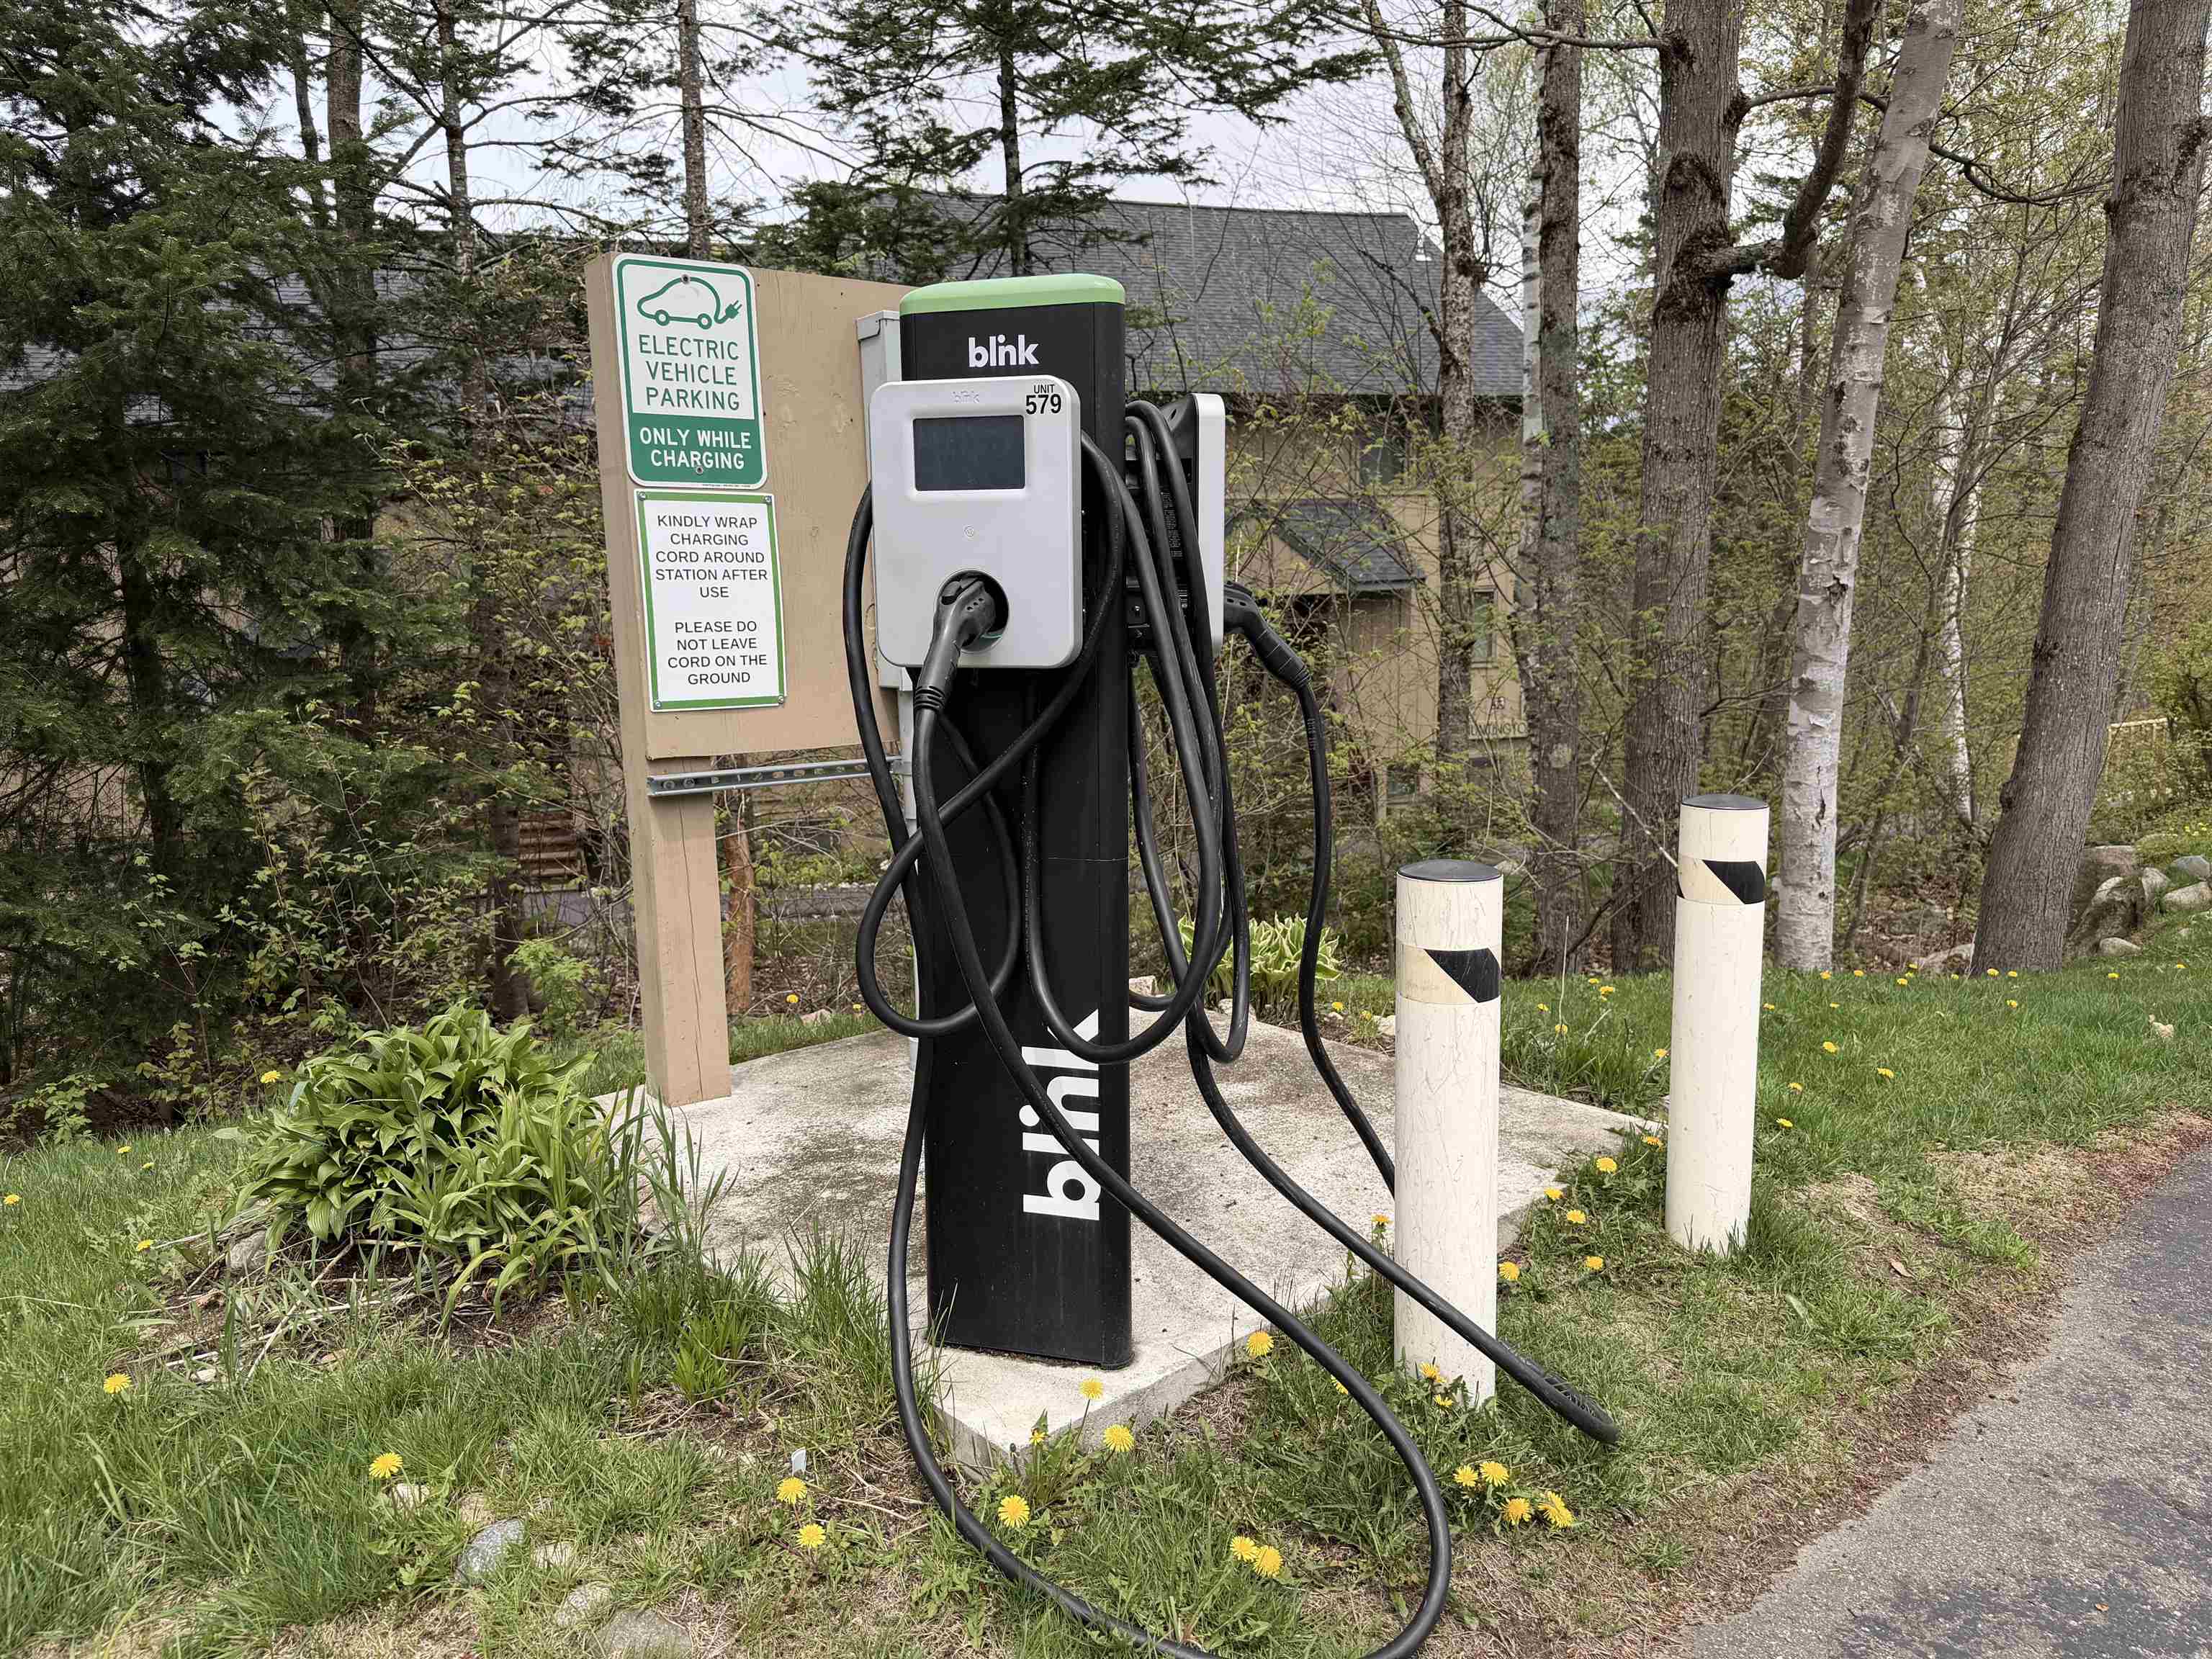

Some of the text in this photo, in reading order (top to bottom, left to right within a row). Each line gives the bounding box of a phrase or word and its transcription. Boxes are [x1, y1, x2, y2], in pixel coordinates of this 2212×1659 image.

[639, 334, 739, 360] ELECTRIC
[968, 335, 1040, 368] blink
[646, 361, 737, 385] VEHICLE
[1033, 384, 1055, 394] UNIT
[646, 387, 739, 410] PARKING
[1025, 394, 1061, 415] 579
[639, 428, 752, 449] ONLY WHILE
[651, 450, 745, 469] CHARGING
[657, 516, 757, 528] KINDLY WRAP
[670, 534, 748, 546] CHARGING
[656, 551, 765, 563] CORD AROUND
[656, 569, 768, 580] STATION AFTER
[700, 587, 729, 598] USE
[675, 621, 757, 633] PLEASE DO
[677, 638, 757, 650] NOT LEAVE
[668, 655, 767, 667] CORD ON THE
[688, 672, 750, 684] GROUND
